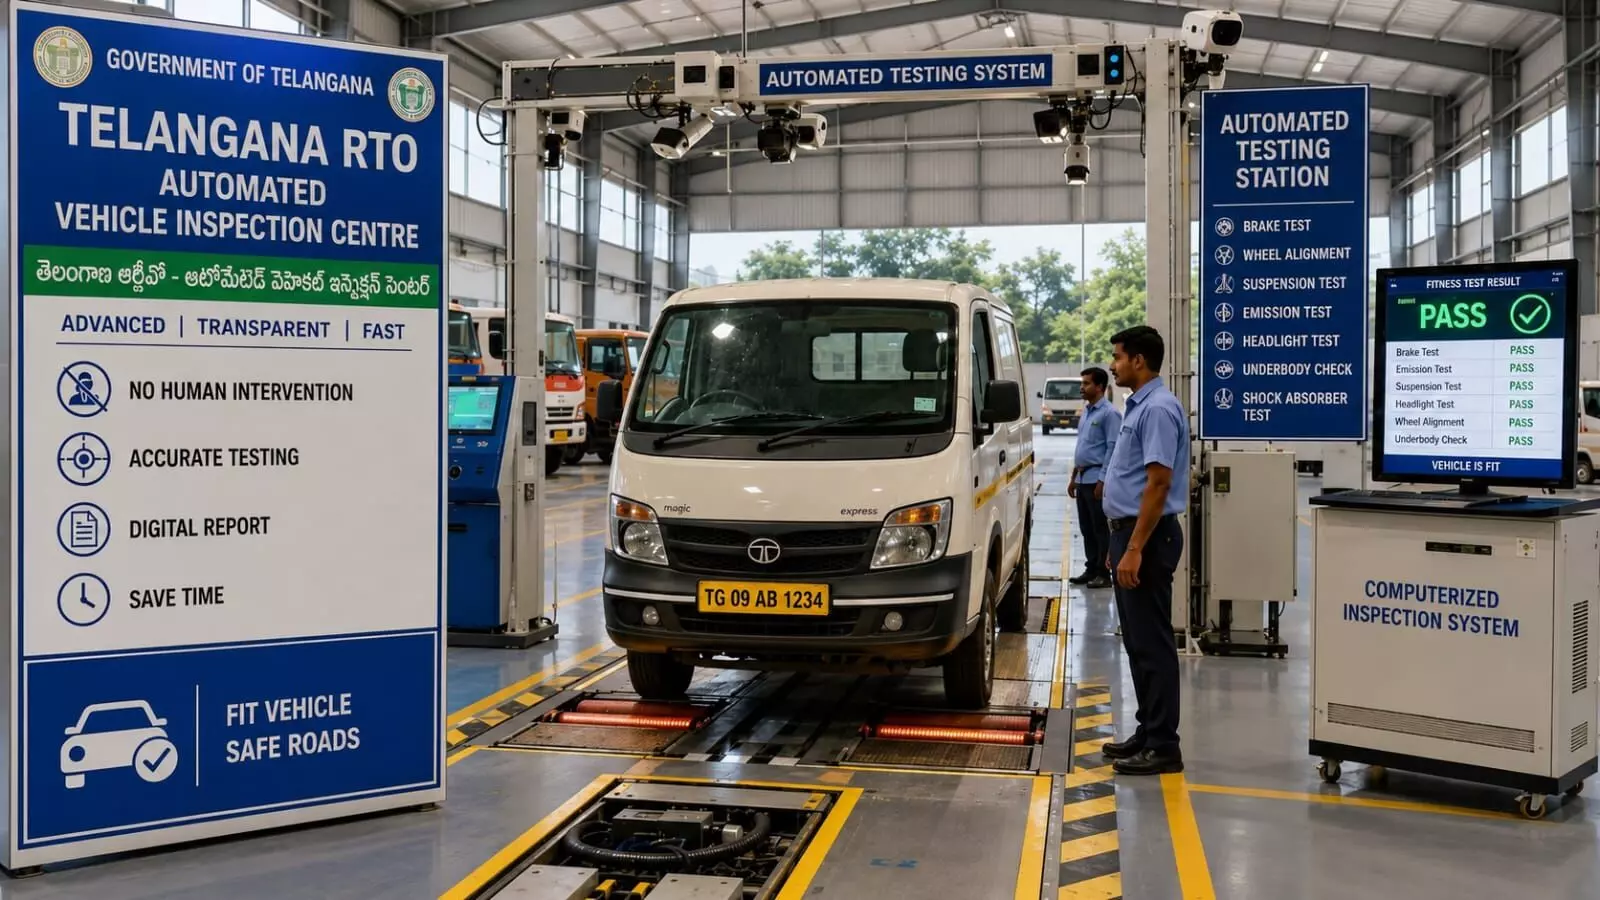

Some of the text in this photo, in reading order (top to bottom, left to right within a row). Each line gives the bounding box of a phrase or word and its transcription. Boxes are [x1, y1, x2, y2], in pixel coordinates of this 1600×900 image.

[106, 48, 237, 81] GOVERNMENT
[242, 63, 266, 84] OF
[271, 66, 375, 96] TELANGANA
[766, 62, 1046, 88] AUTOMATED TESTING SYSTEM
[1220, 110, 1350, 135] AUTOMATED
[58, 101, 419, 174] TELANGANA RTO
[1235, 137, 1330, 162] TESTING
[1235, 165, 1329, 189] STATION
[159, 168, 327, 207] AUTOMATED
[54, 201, 420, 249] VEHICLE INSPECTION CENTRE
[1243, 218, 1312, 233] BRAKE TEST
[1242, 246, 1352, 262] WHEEL ALIGNMENT
[1242, 276, 1347, 290] SUSPENSION TEST
[1426, 276, 1521, 289] FITNESS TEST RESULT
[1242, 305, 1333, 319] EMISSION TEST
[1420, 301, 1488, 329] PASS
[61, 314, 406, 340] ADVANCED TRANSPARENT FAST
[1242, 333, 1340, 348] HEADLIGHT TEST
[1396, 347, 1440, 358] Brake Test
[1509, 345, 1535, 356] PASS
[1242, 362, 1353, 376] UNDERBODY CHECK
[1395, 364, 1453, 374] Emission Test
[1509, 362, 1535, 373] PASS
[129, 380, 353, 402] NO HUMAN INTERVENTION
[1395, 381, 1462, 393] Suspension Test
[1509, 380, 1534, 391] PASS
[1242, 391, 1348, 405] SHOCK ABSORBER
[1395, 399, 1455, 411] Headlight Test
[1508, 399, 1534, 409] PASS
[1242, 408, 1272, 423] TEST
[1394, 416, 1465, 429] Wheel Alignment
[1508, 417, 1534, 428] PASS
[1394, 434, 1468, 446] Underbody Check
[1508, 435, 1534, 446] PASS
[128, 447, 300, 468] ACCURATE TESTING
[1431, 460, 1501, 473] VEHICLE IS FIT
[840, 507, 879, 518] express
[129, 515, 271, 539] DIGITAL REPORT
[129, 585, 225, 610] SAVE TIME
[704, 588, 824, 610] TG 09 AB 1234
[1364, 580, 1500, 609] COMPUTERIZED
[1342, 603, 1519, 638] INSPECTION SYSTEM
[226, 693, 352, 727] FIT VEHICLE
[226, 727, 361, 764] SAFE ROADS
